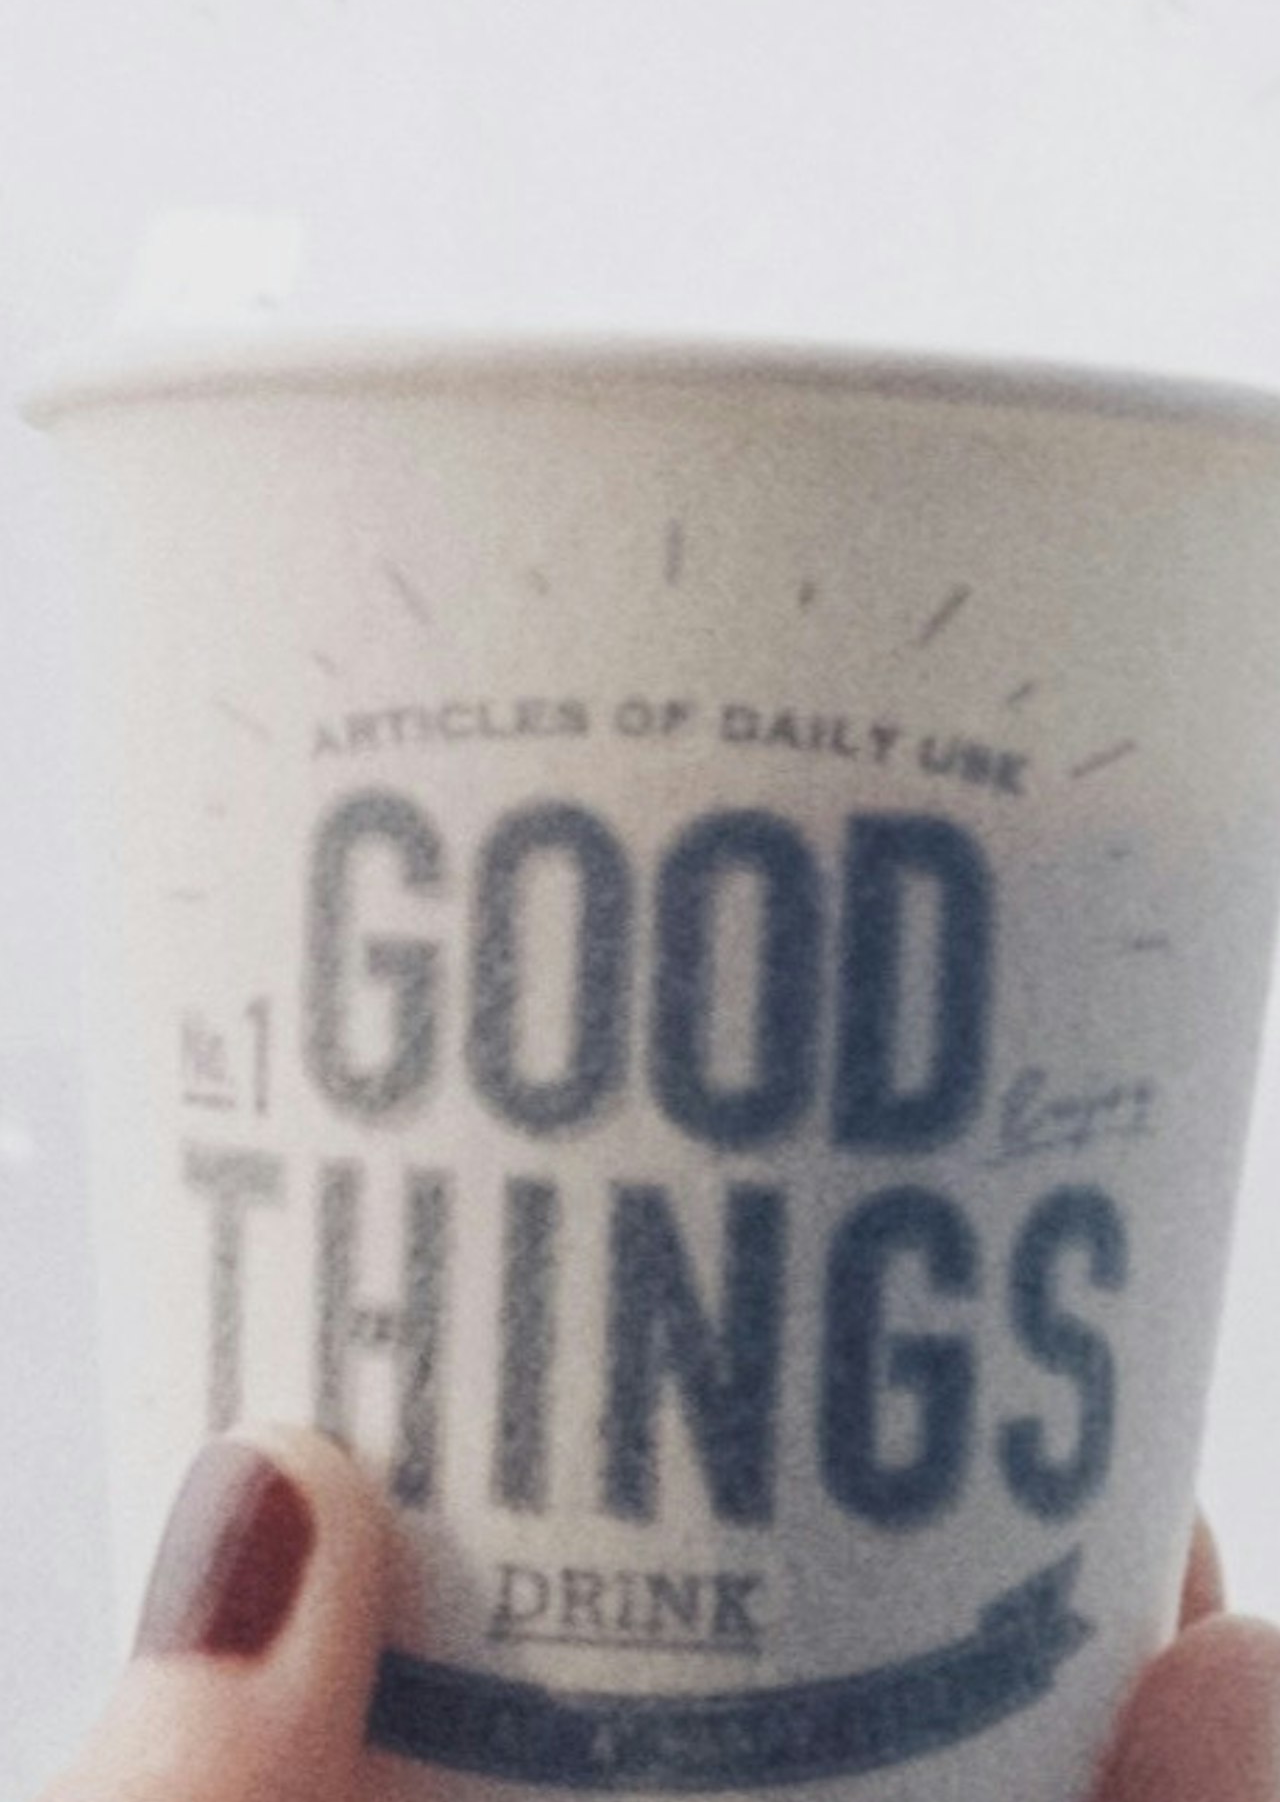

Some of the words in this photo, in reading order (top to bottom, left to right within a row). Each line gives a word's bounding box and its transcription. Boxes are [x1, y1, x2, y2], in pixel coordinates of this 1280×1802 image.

[313, 696, 588, 757] ARTICLES
[614, 696, 694, 739] OF
[721, 704, 900, 764] DAILY
[303, 786, 998, 1154] GOOD
[178, 1138, 1130, 1533] THINGS
[492, 1562, 762, 1640] DRINK
